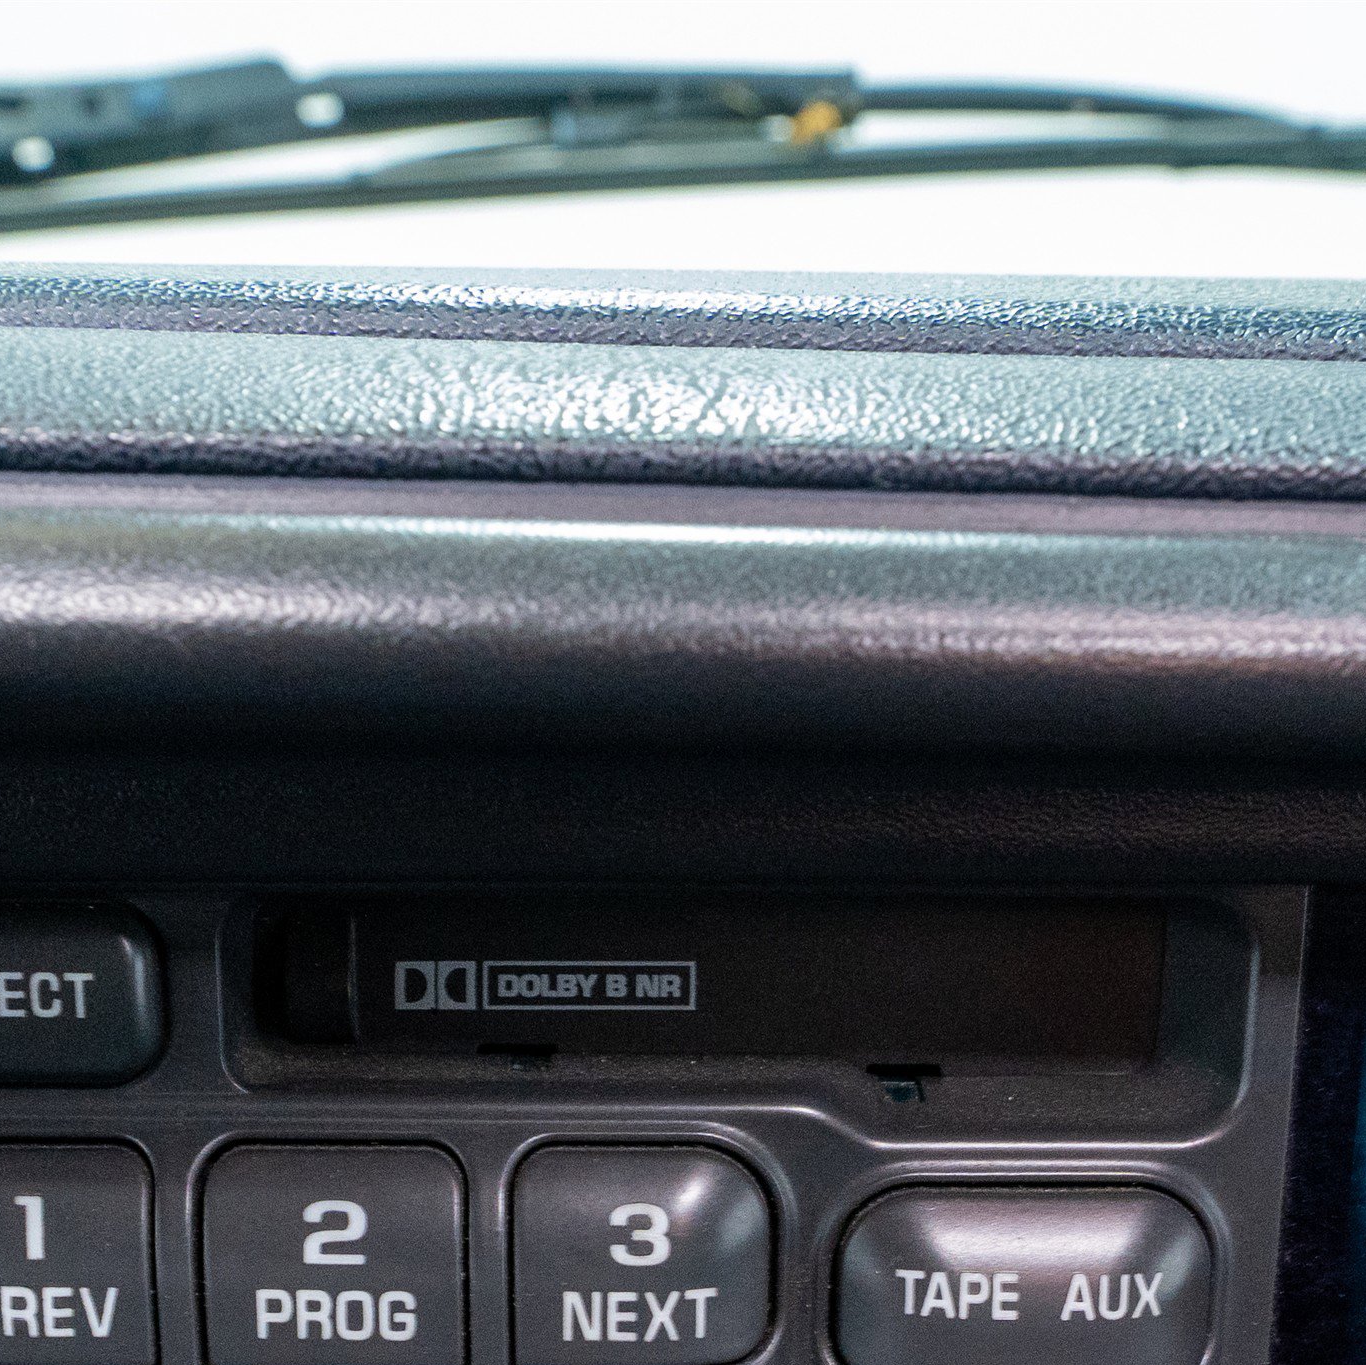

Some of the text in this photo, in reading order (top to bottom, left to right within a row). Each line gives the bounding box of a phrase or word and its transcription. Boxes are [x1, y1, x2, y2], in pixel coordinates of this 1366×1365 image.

[497, 973, 682, 999] DOLBY B NR
[15, 1195, 45, 1260] 1
[303, 1200, 368, 1266] 2
[609, 1202, 673, 1267] 3
[255, 1288, 417, 1342] PROG
[562, 1287, 718, 1342] NEXT
[895, 1269, 1166, 1322] TAPE AUX
